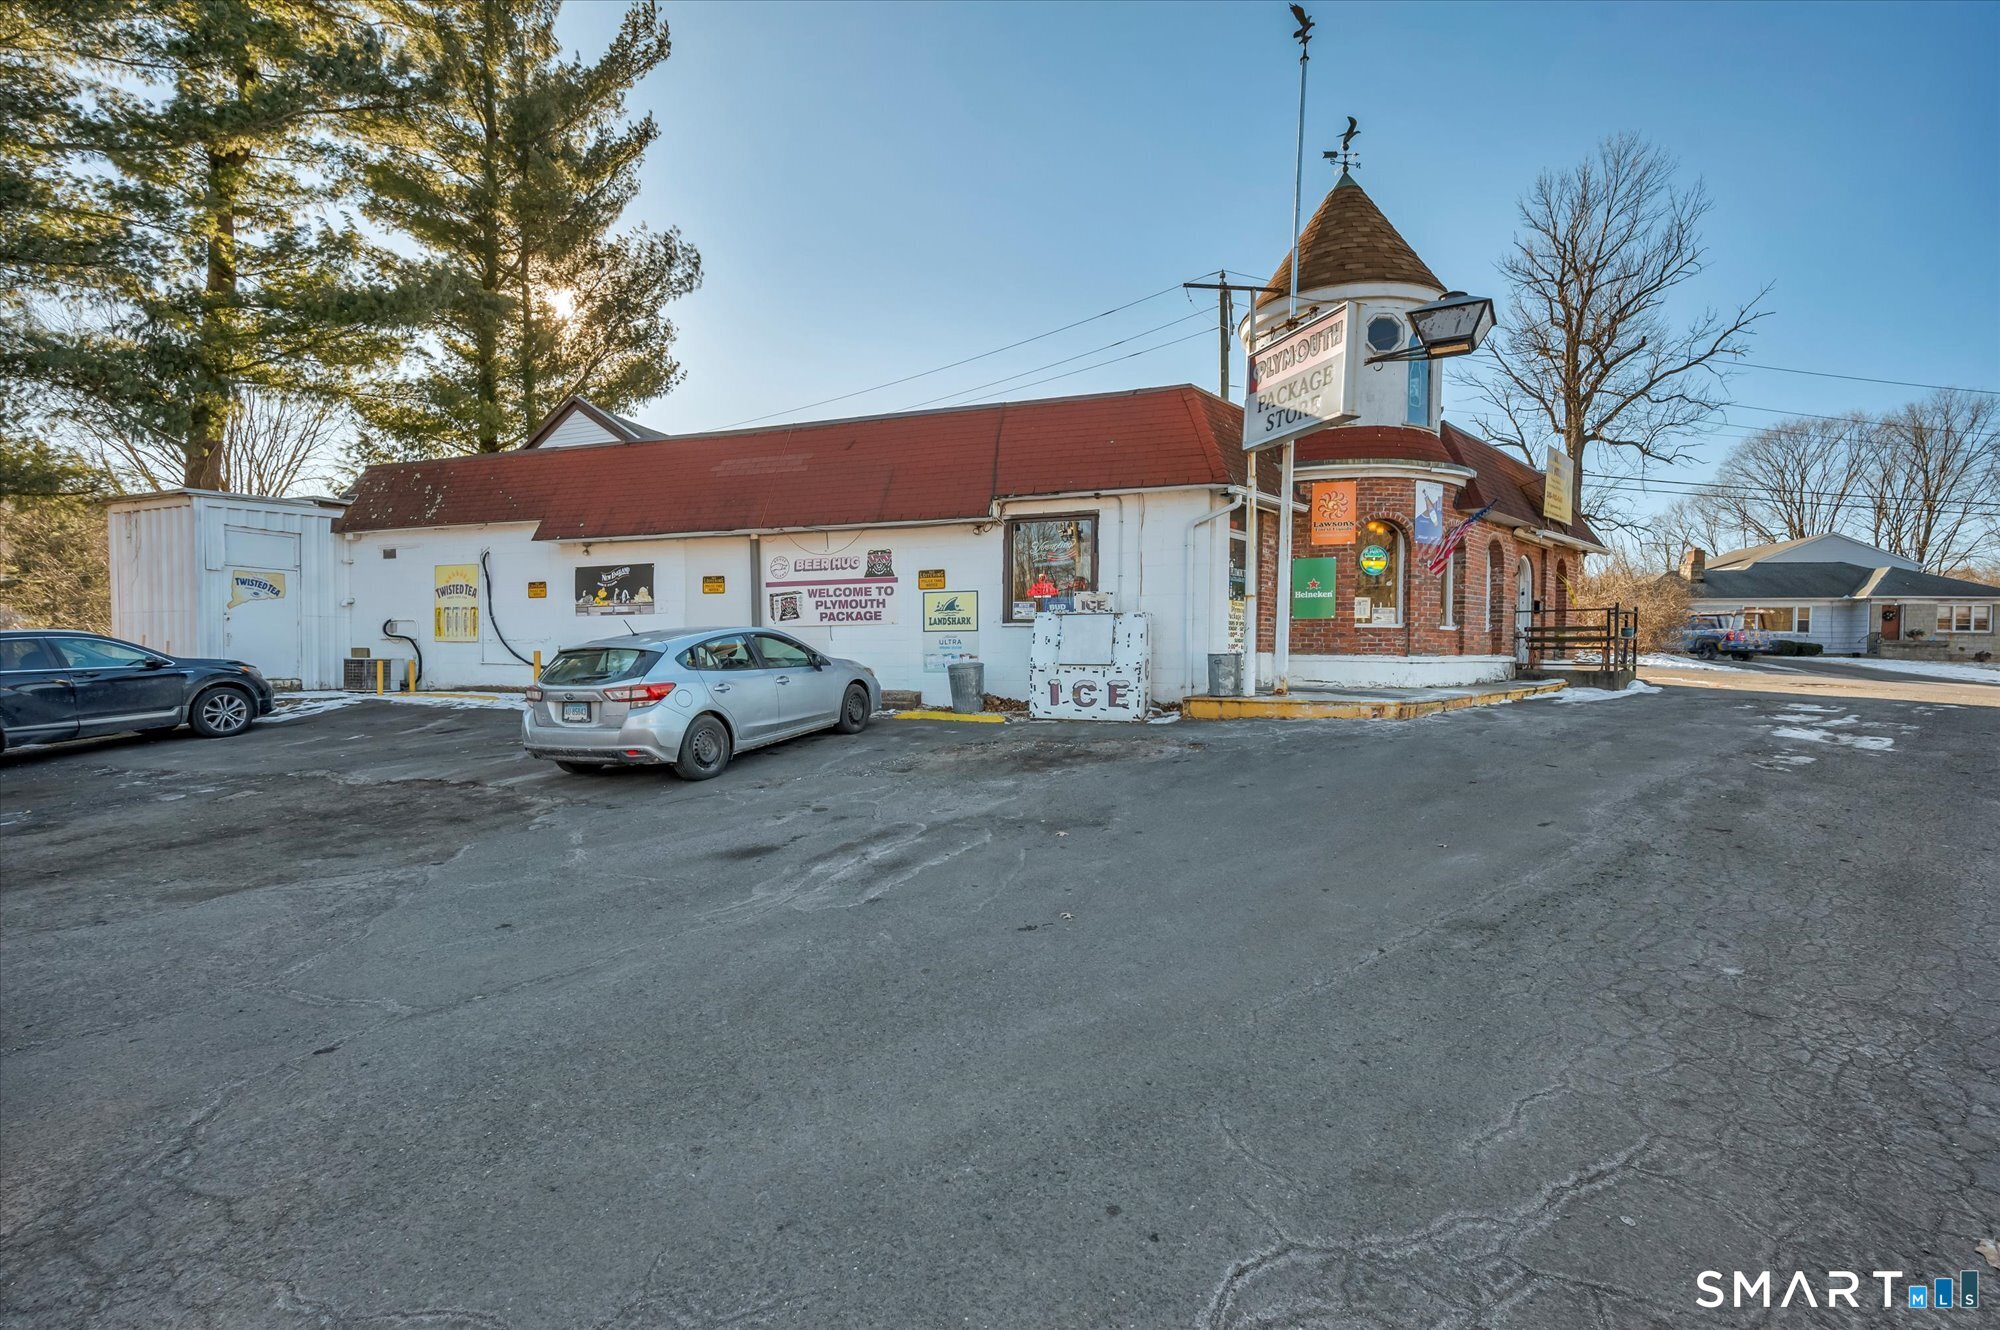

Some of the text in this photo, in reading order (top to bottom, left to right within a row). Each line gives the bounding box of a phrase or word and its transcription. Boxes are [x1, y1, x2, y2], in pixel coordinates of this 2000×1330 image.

[1253, 319, 1344, 385] PLYMOUTH
[1257, 364, 1334, 413] PACKAGE
[1265, 394, 1321, 432] STORE
[794, 556, 860, 572] BEER HUG
[235, 577, 268, 590] TWISTED
[267, 584, 281, 597] TEA
[435, 583, 478, 599] TWISTED TEA
[807, 585, 895, 599] WELCOME TO
[1295, 590, 1333, 599] Heineken
[815, 598, 886, 610] PLYMOUTH
[1081, 599, 1106, 611] ICE
[819, 610, 882, 622] PACKAGE
[928, 616, 971, 626] LANDSHARK
[1047, 678, 1131, 708] ICE
